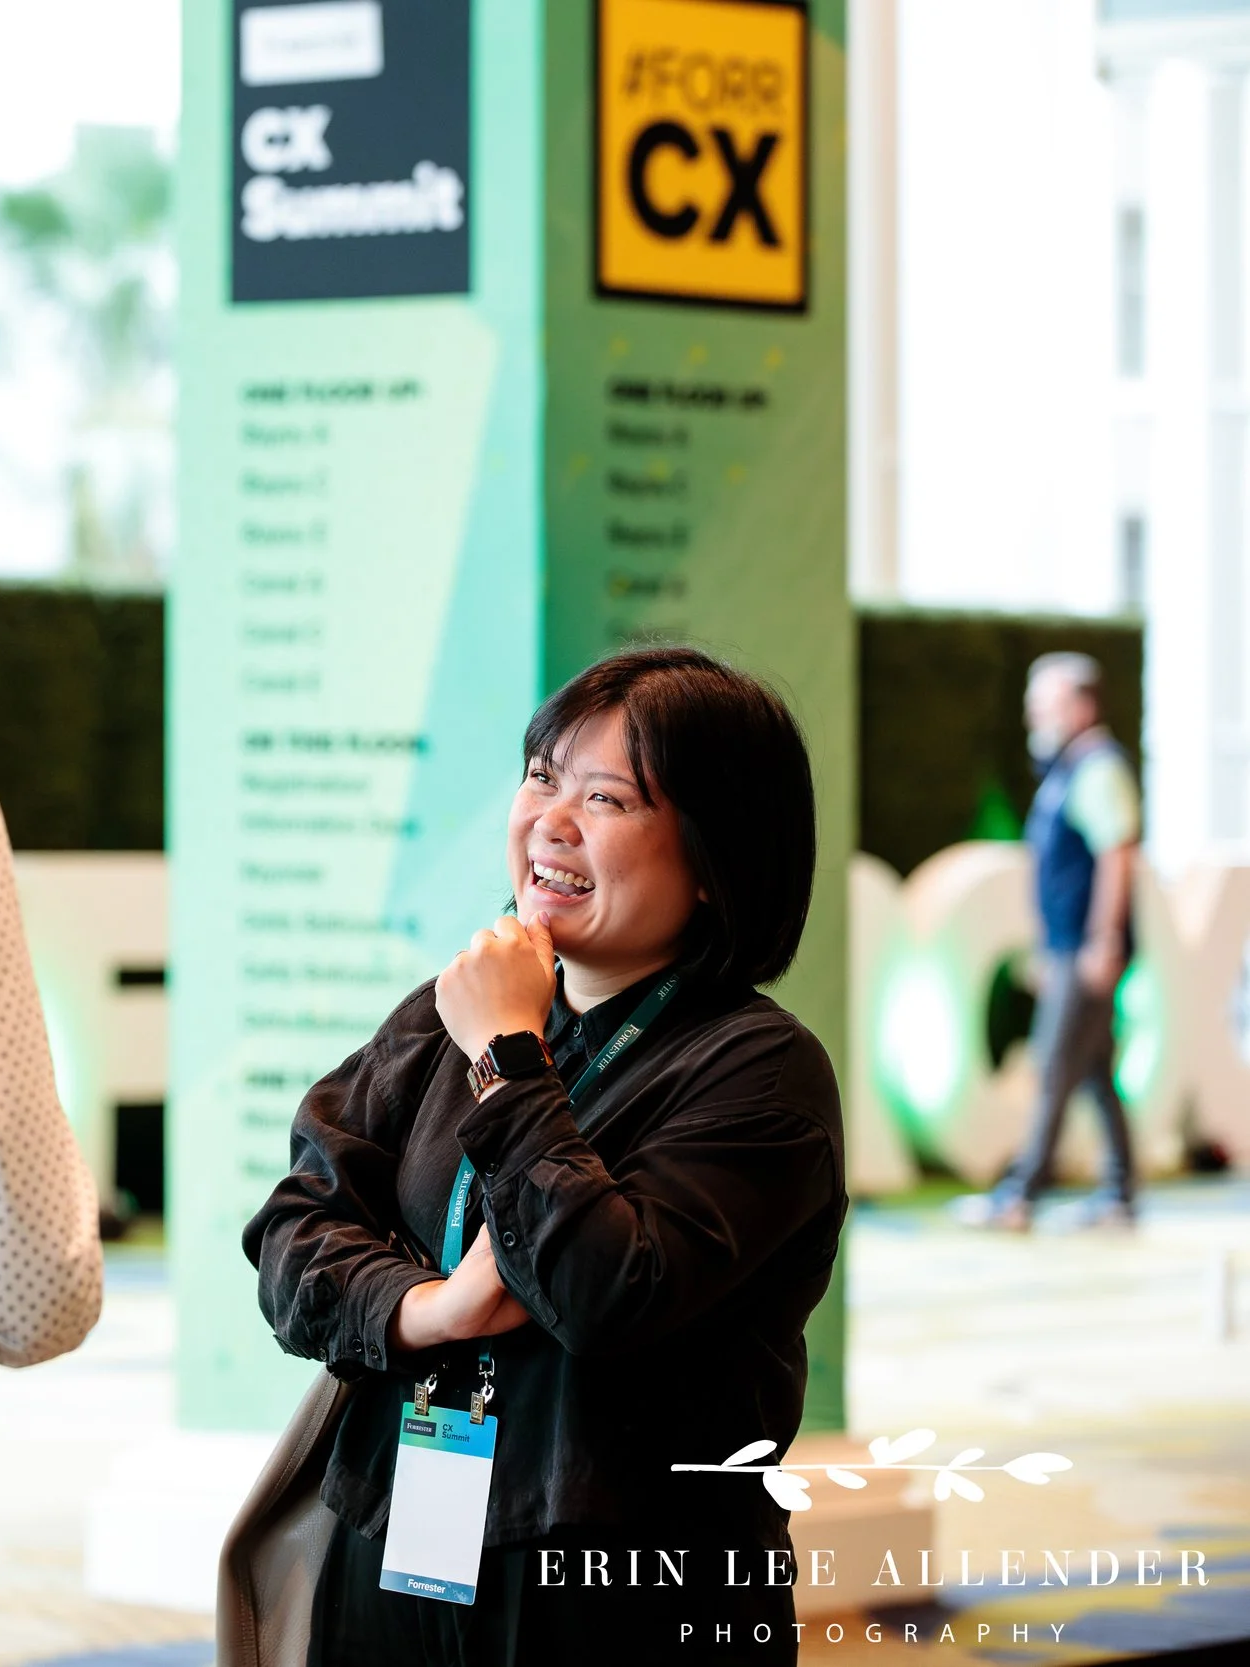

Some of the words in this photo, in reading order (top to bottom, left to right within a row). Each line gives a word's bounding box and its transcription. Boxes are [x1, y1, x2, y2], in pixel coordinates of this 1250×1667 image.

[623, 46, 784, 111] #FORR
[242, 105, 331, 173] CX
[242, 160, 463, 241] Summit
[626, 119, 783, 249] CX
[441, 1431, 471, 1443] Summit
[442, 1423, 453, 1432] CX
[407, 1578, 446, 1594] Forrester
